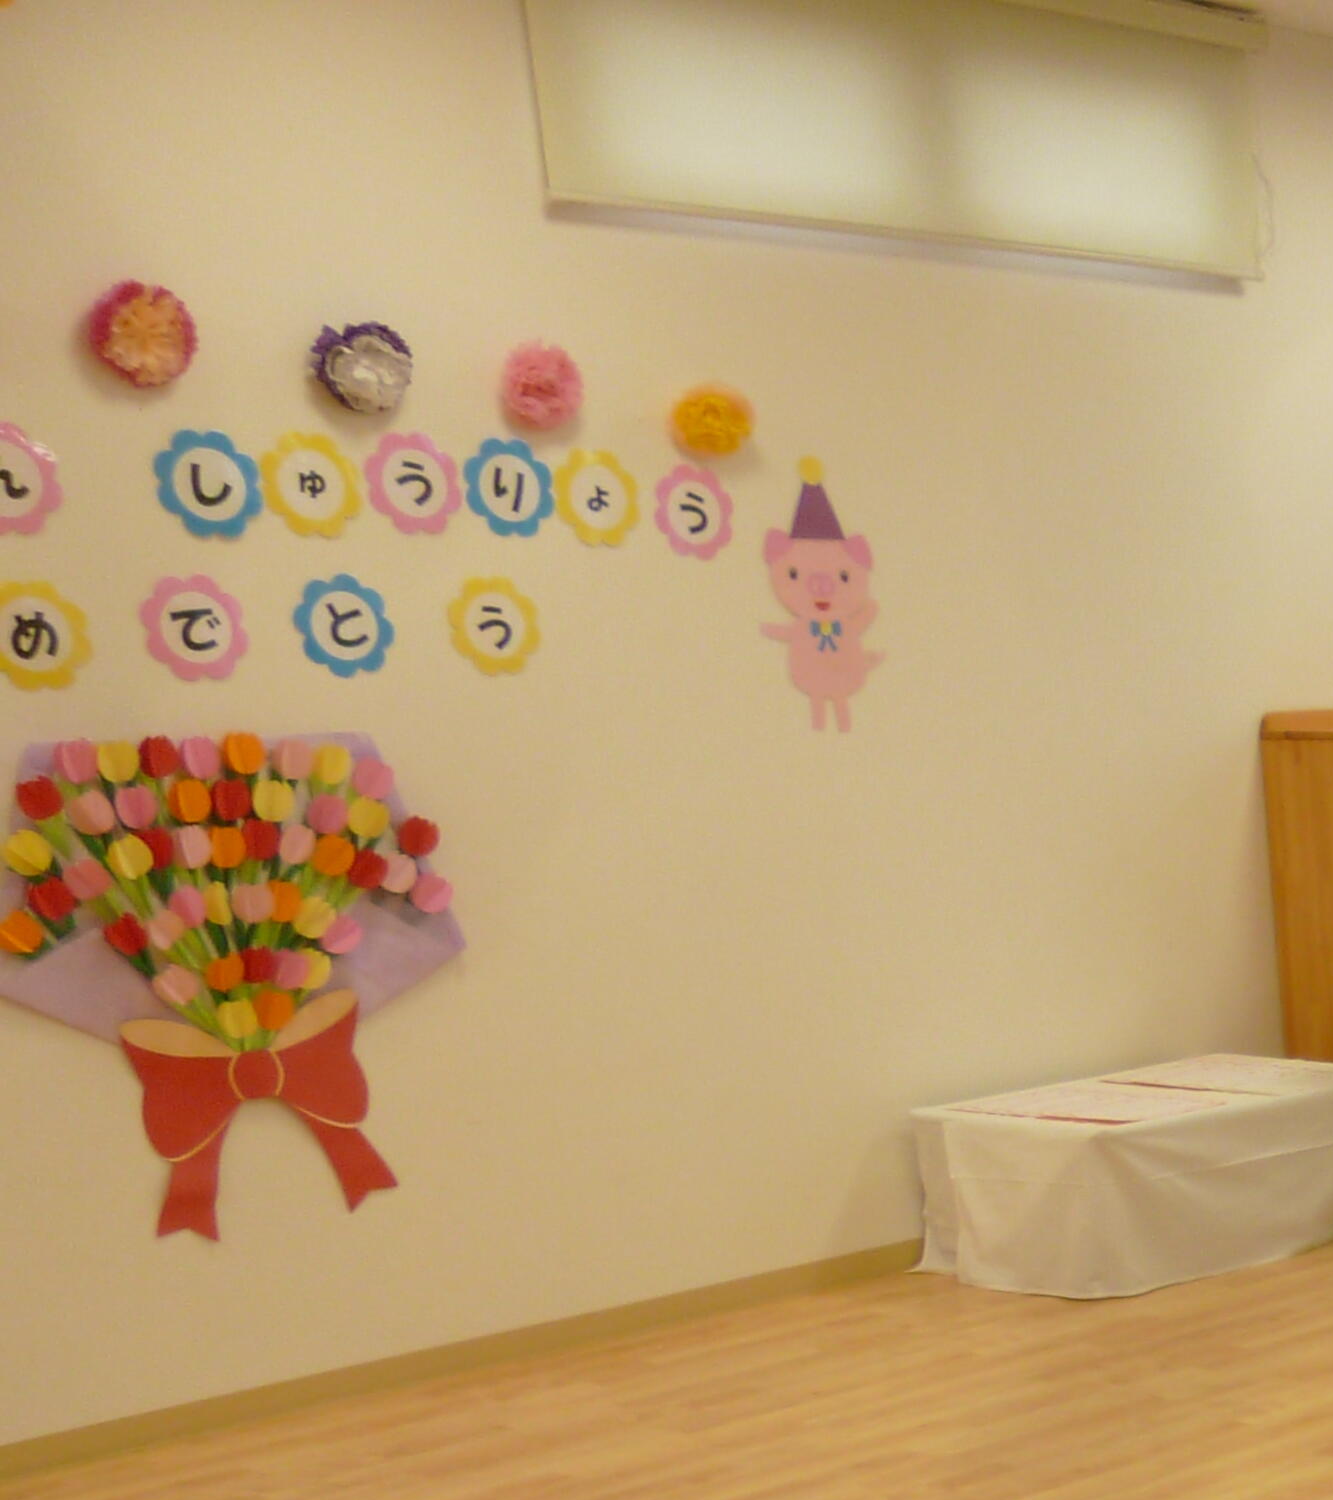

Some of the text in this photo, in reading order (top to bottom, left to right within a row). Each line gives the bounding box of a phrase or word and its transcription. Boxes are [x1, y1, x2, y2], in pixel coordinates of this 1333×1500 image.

[190, 462, 707, 534] しゅうりょう
[11, 605, 512, 660] めでとう
